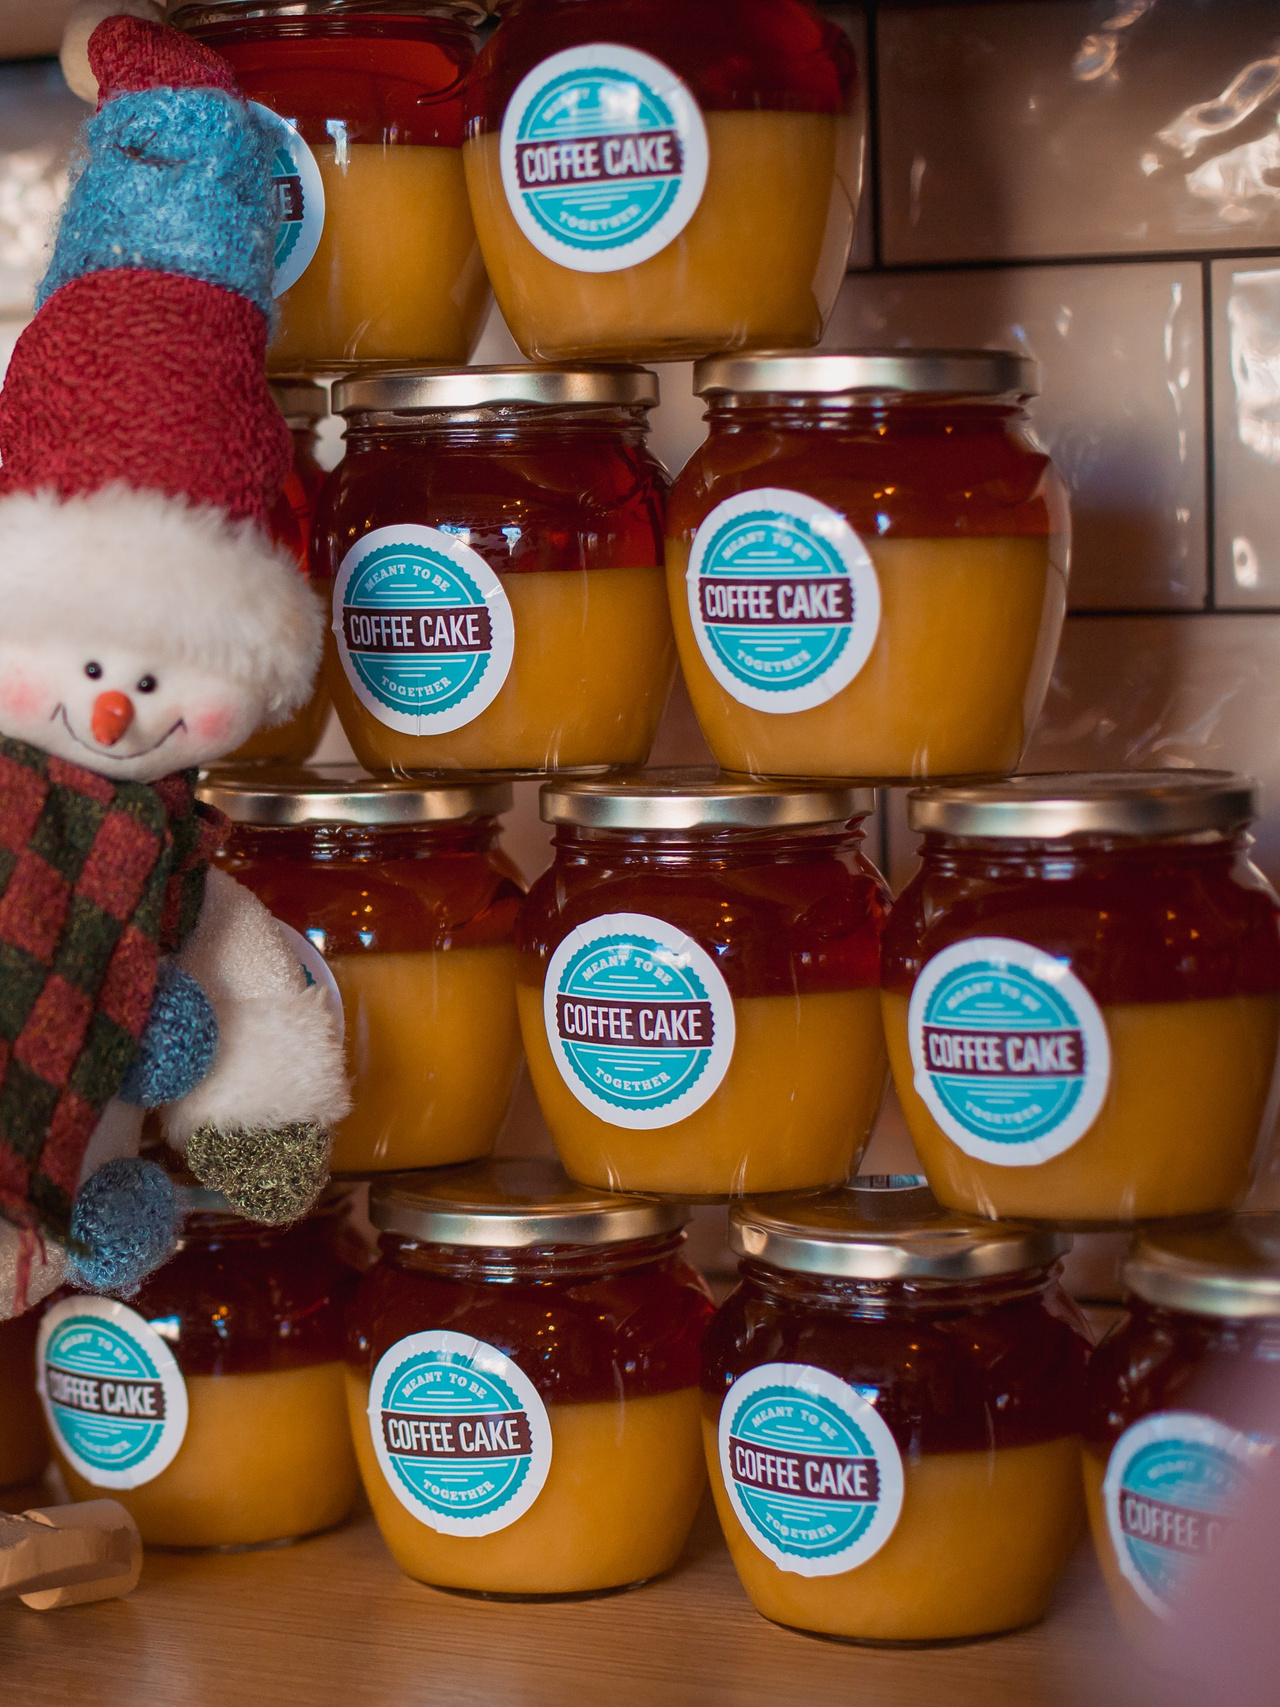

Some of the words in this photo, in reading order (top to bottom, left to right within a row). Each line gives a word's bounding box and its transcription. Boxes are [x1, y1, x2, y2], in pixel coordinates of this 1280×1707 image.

[522, 142, 601, 183] COFFEE
[603, 135, 674, 176] CAKE
[364, 564, 406, 592] MEANT
[412, 565, 431, 580] TO
[431, 574, 451, 593] BE
[704, 584, 774, 620] COFFEE
[776, 583, 844, 620] CAKE
[350, 614, 415, 647] COFFEE
[419, 614, 481, 647] CAKE
[381, 675, 452, 698] TOGETHER
[581, 954, 628, 982] MEANT
[633, 957, 653, 973] TO
[653, 966, 674, 986] BE
[563, 1002, 634, 1040] COFFEE
[638, 1008, 703, 1041] CAKE
[928, 1033, 1004, 1071] COFFEE
[1005, 1034, 1077, 1072] CAKE
[595, 1066, 671, 1092] TOGETHER
[101, 1382, 158, 1416] CAKE
[401, 1371, 443, 1398] MEANT
[449, 1372, 467, 1387] TO
[468, 1381, 488, 1400] BE
[751, 1406, 794, 1428] MEANT
[800, 1409, 819, 1426] TO
[387, 1418, 456, 1453] COFFEE
[458, 1419, 521, 1453] CAKE
[735, 1445, 801, 1491] COFFEE
[805, 1460, 869, 1496] CAKE
[423, 1479, 495, 1502] TOGETHER
[765, 1512, 837, 1541] TOGETHER
[1124, 1497, 1199, 1550] COFFEE
